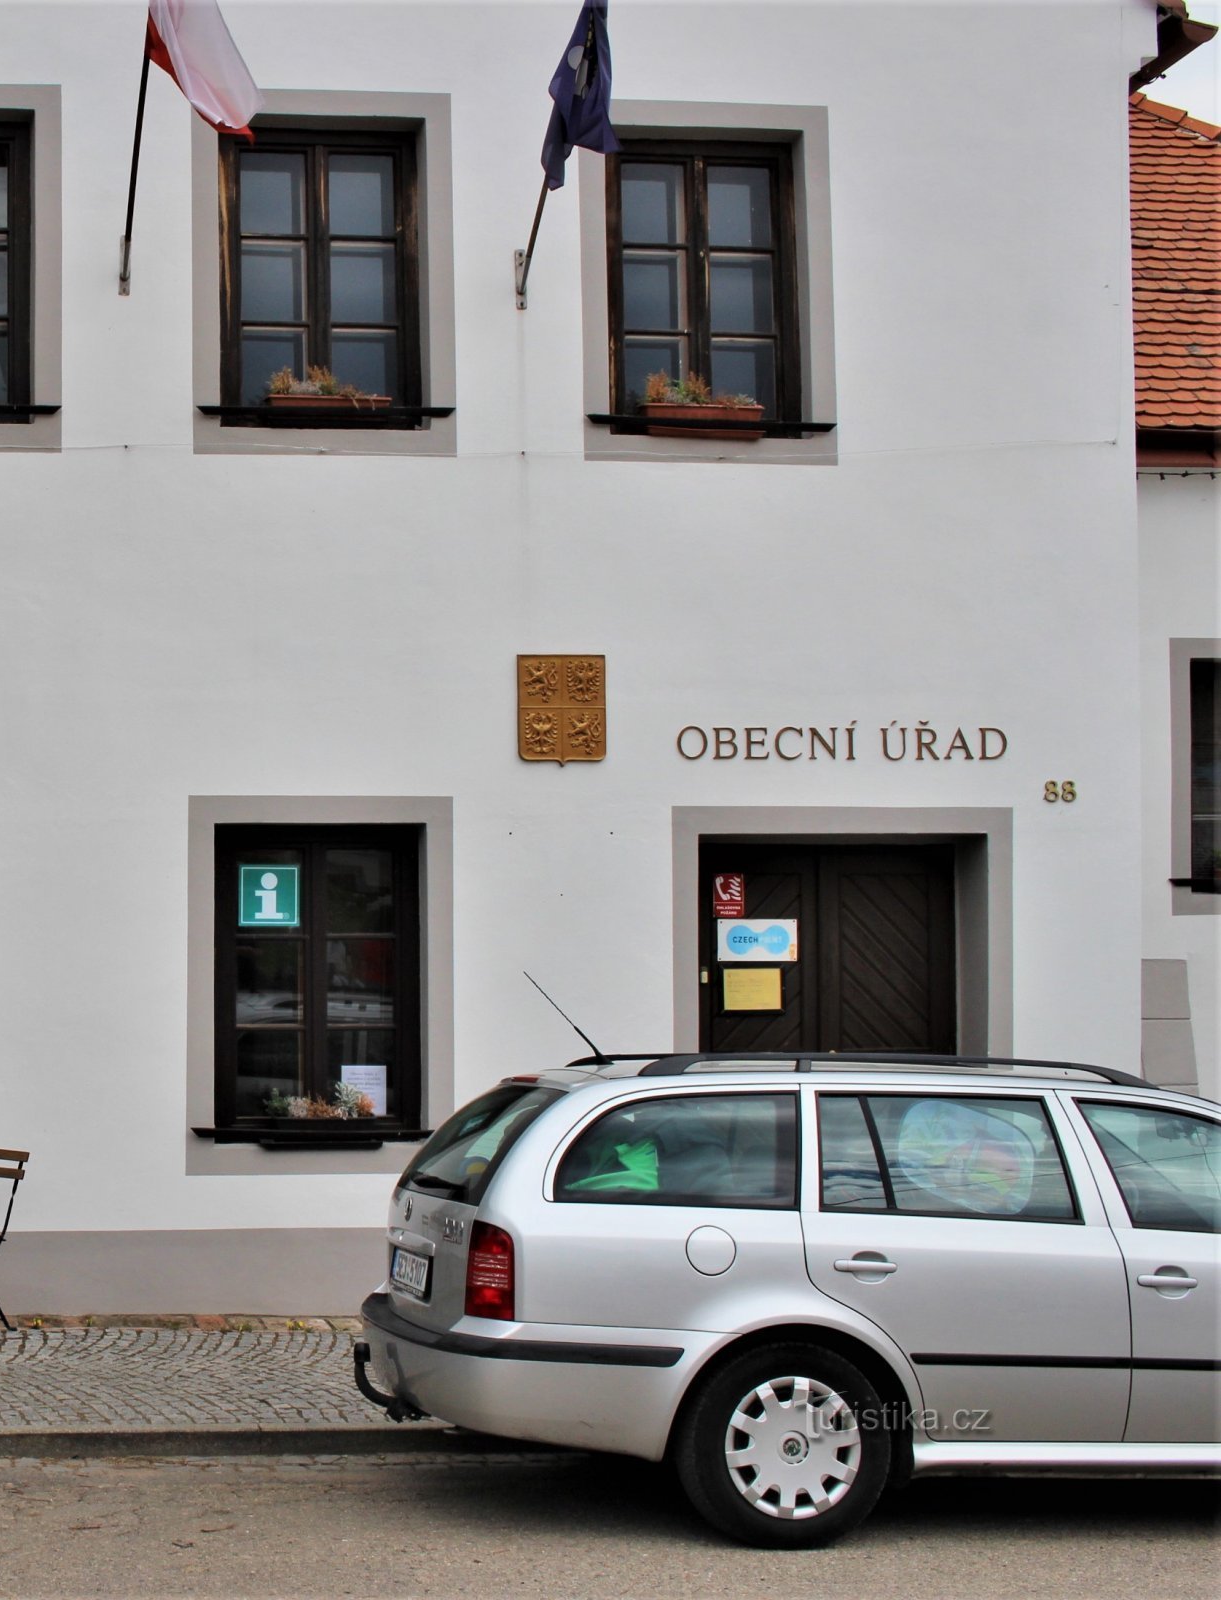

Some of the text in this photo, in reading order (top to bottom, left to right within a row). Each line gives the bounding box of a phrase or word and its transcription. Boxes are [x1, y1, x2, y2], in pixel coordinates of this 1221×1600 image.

[676, 720, 1008, 761] OBECNÍ ÚŘAD
[1043, 780, 1078, 803] 88
[732, 936, 759, 944] CZECH
